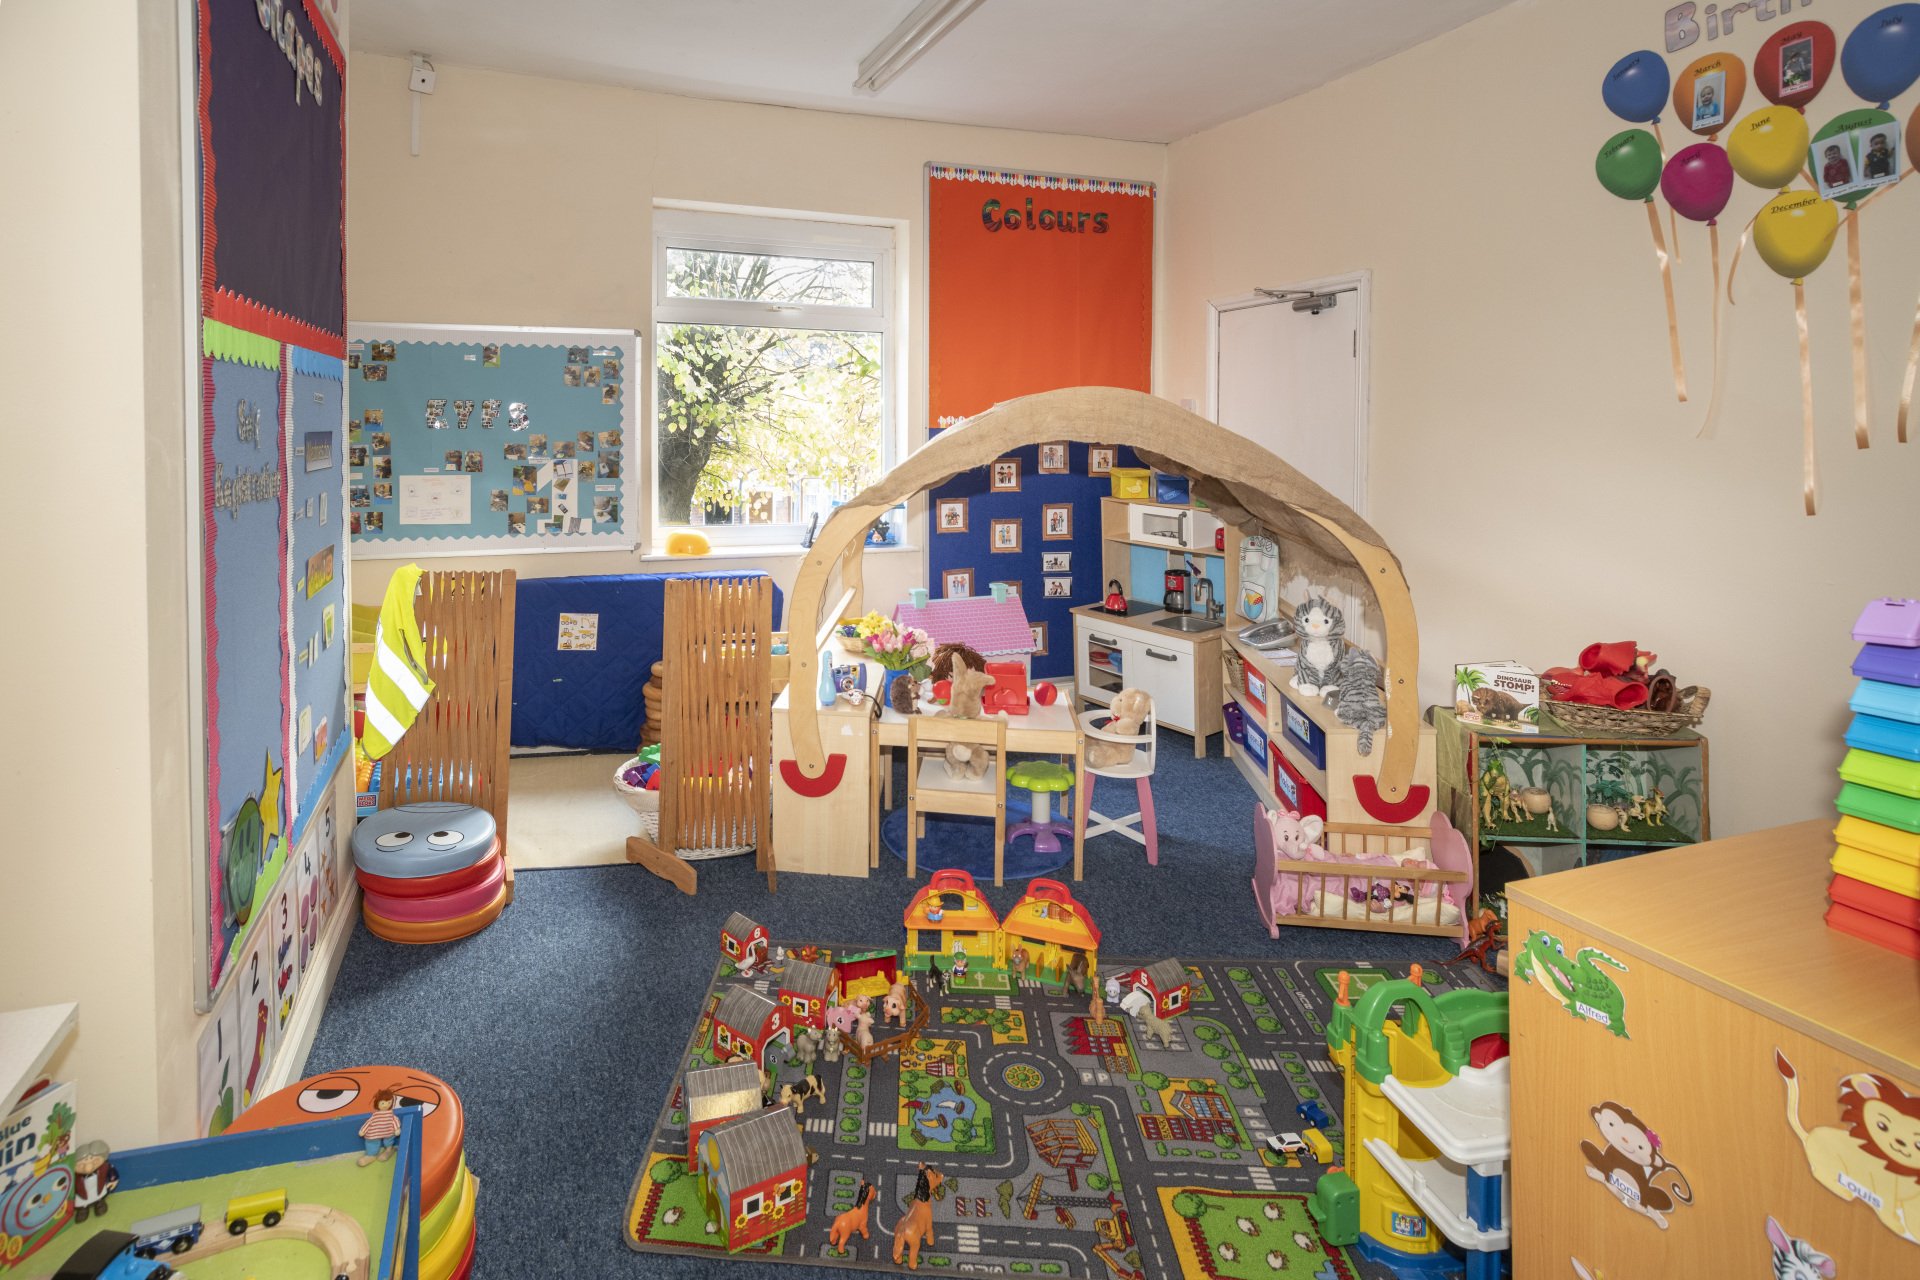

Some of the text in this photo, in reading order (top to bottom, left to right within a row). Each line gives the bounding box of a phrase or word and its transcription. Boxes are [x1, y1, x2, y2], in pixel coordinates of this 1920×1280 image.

[1694, 59, 1722, 77] March
[1750, 116, 1771, 131] June
[1835, 118, 1873, 132] August
[1604, 134, 1635, 159] February
[981, 197, 1110, 234] Colours
[1771, 197, 1818, 214] December
[237, 399, 261, 449] Self
[425, 398, 531, 432] EYFS
[214, 462, 282, 520] Registration
[1493, 679, 1535, 693] STOMP!
[1496, 674, 1533, 685] DINOSAUR
[325, 806, 331, 835] 5
[303, 851, 312, 876] 4
[280, 893, 288, 931] 3
[250, 951, 260, 997] 2
[1141, 971, 1148, 986] 5
[771, 1013, 780, 1030] 3
[837, 1016, 843, 1024] 4
[1578, 1003, 1609, 1024] Alfred
[217, 1018, 222, 1062] 1
[771, 1055, 777, 1063] 3
[1082, 1072, 1108, 1083] P P
[1244, 1107, 1260, 1117] P
[1157, 1117, 1171, 1139] BANK
[1249, 1119, 1266, 1128] P
[1608, 1173, 1640, 1201] Mona
[1837, 1172, 1881, 1209] Louis
